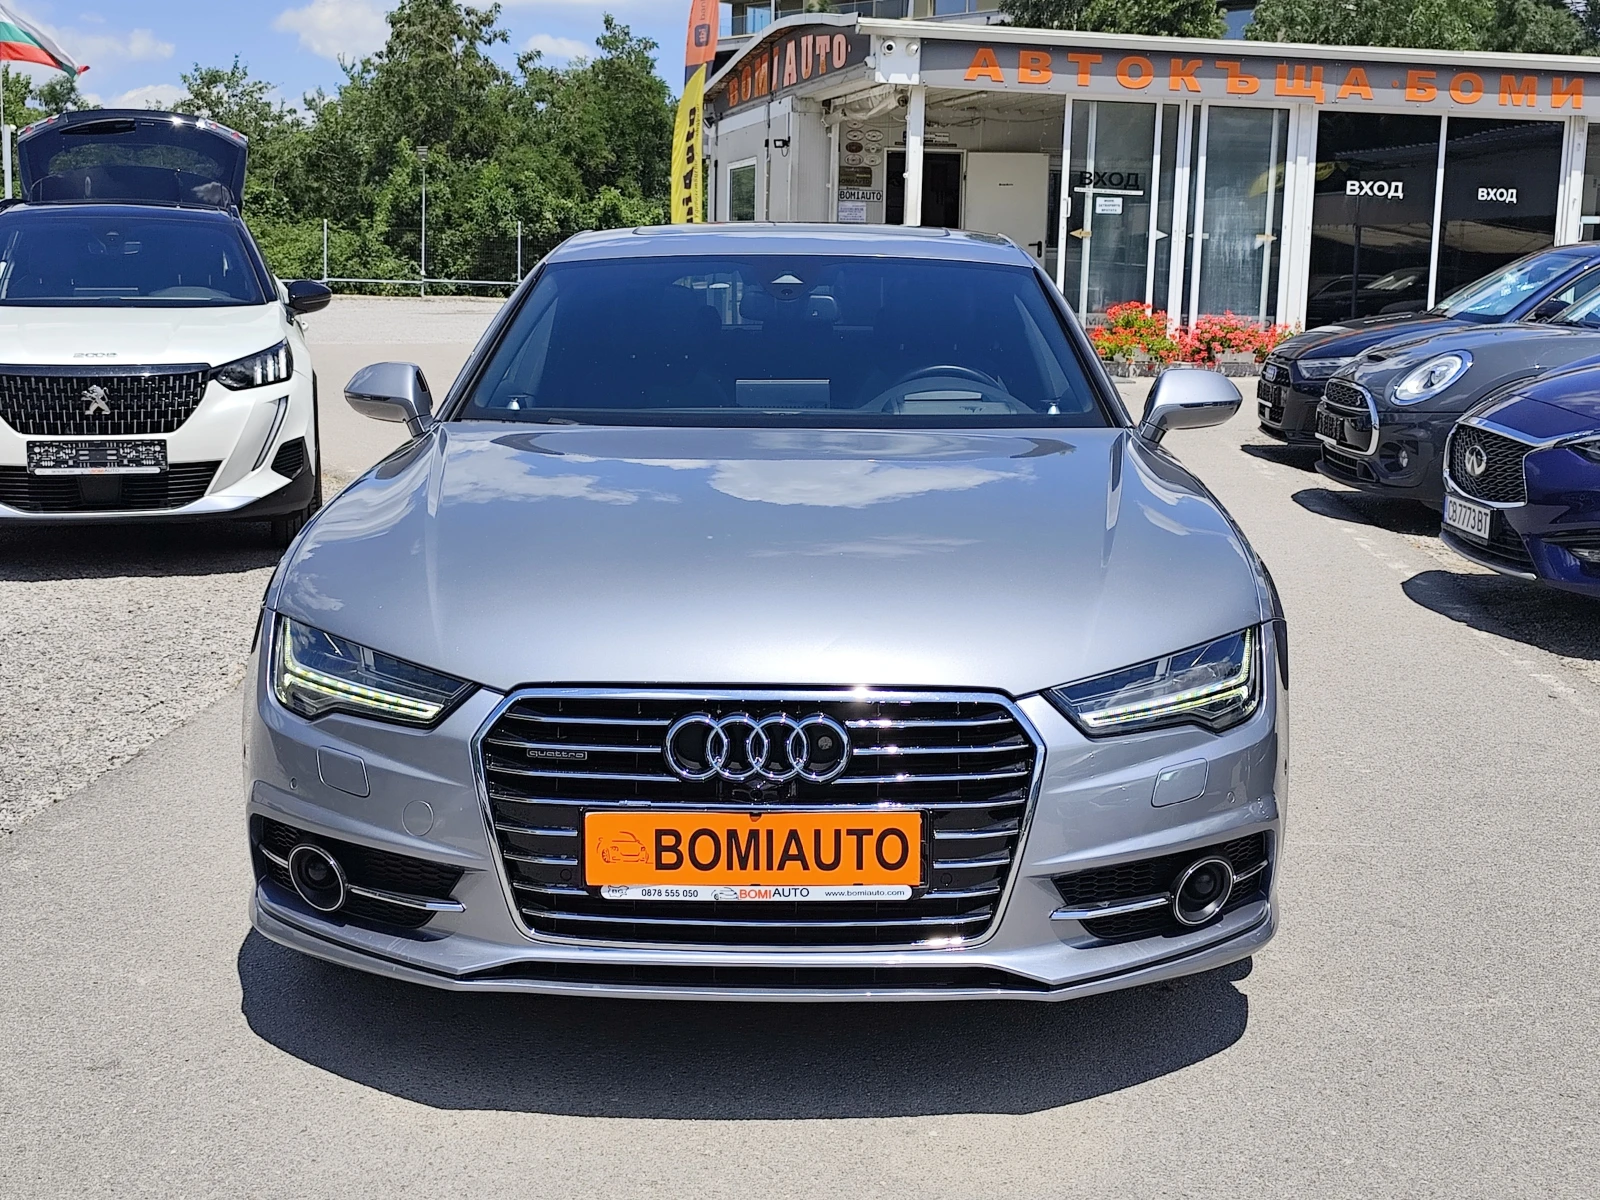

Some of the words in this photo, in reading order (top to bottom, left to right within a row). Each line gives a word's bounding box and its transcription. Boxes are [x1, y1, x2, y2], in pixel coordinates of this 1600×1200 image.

[728, 33, 847, 107] BOMIAUTO
[964, 47, 1374, 104] АВТОКЪЩА
[1404, 69, 1585, 109] БОМИ
[1079, 171, 1140, 190] ВХОД
[839, 190, 882, 201] BOMIAUTO
[1345, 180, 1404, 199] ВХОД
[1477, 188, 1517, 203] ВХОД
[529, 750, 584, 758] quattro
[654, 828, 910, 872] BOMIAUTO
[641, 888, 662, 897] 0878
[664, 889, 680, 897] 555
[682, 889, 698, 898] 050
[739, 887, 810, 899] BOMIAUTO
[824, 889, 905, 897] www.bomiauto.com
